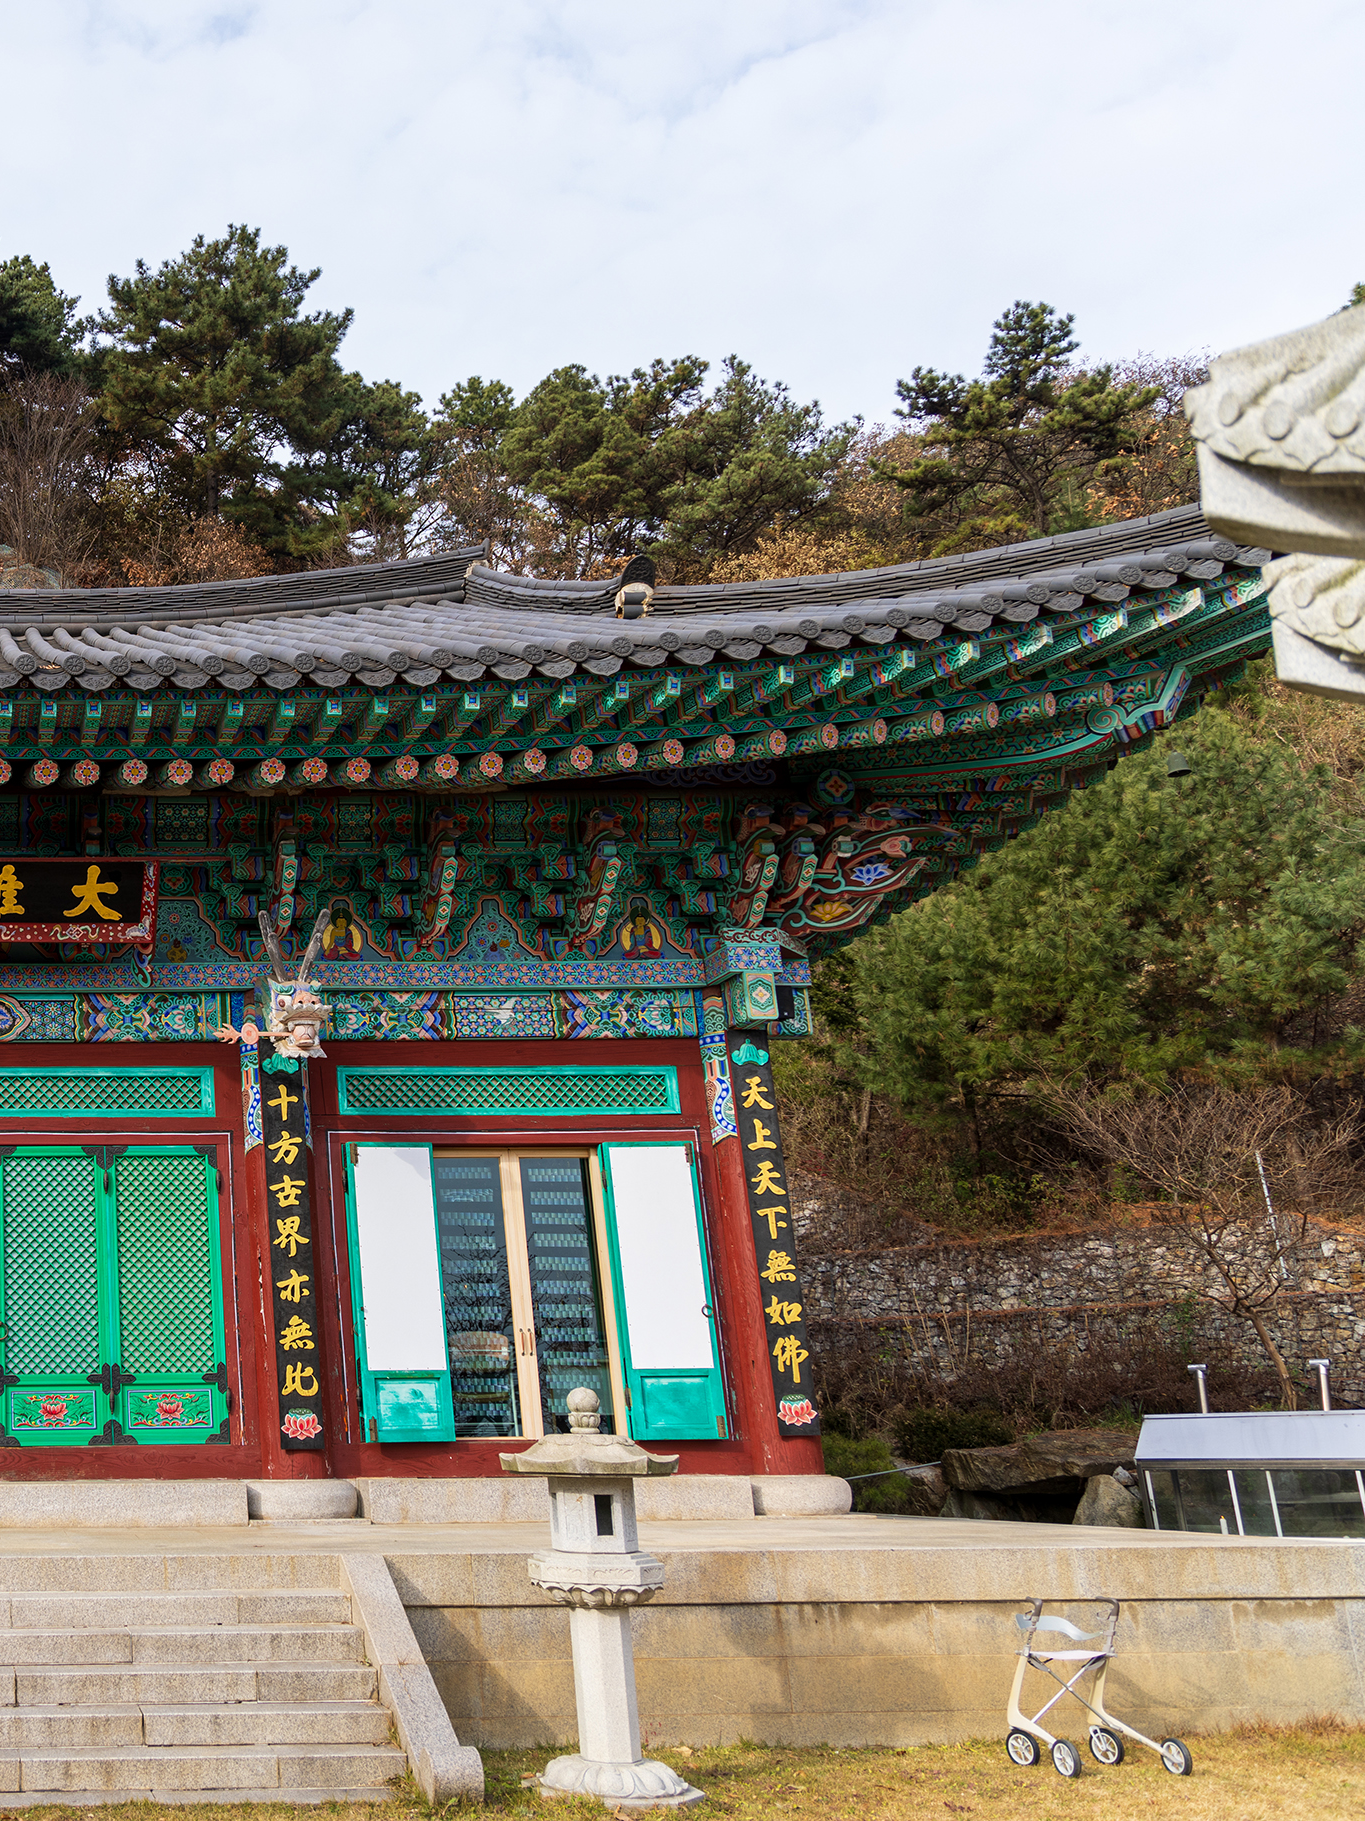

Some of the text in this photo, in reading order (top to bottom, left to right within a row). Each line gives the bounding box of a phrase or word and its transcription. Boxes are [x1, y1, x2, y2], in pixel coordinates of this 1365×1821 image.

[741, 1075, 810, 1384] 天上天下無如佛
